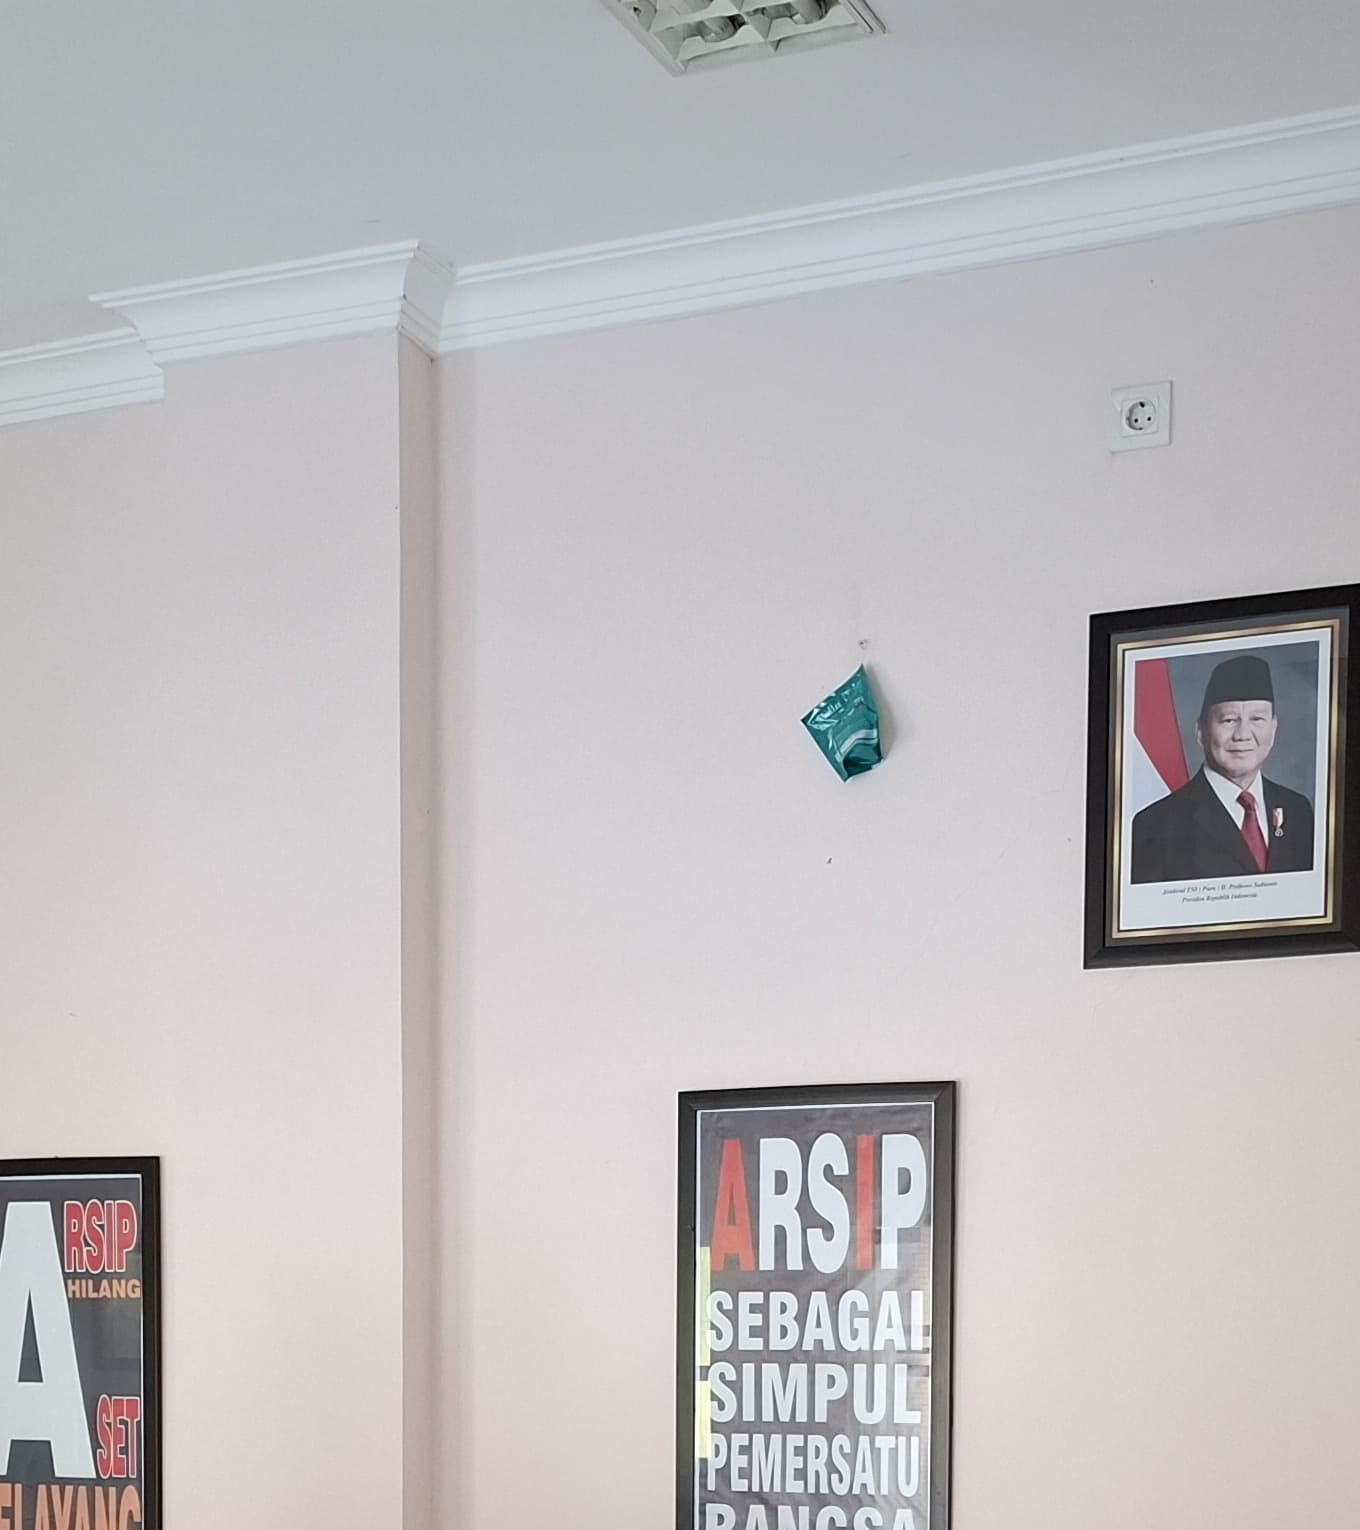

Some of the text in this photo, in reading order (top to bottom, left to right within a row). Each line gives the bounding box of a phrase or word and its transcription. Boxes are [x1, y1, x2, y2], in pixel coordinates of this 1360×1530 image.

[709, 1131, 927, 1274] ARSIP
[63, 1198, 138, 1274] RSIP
[67, 1278, 141, 1299] HILANG
[706, 1289, 923, 1353] SEBAGAI
[707, 1360, 922, 1425] SIMPUL
[95, 1394, 141, 1480] SET
[706, 1433, 920, 1499] PEMERSATU
